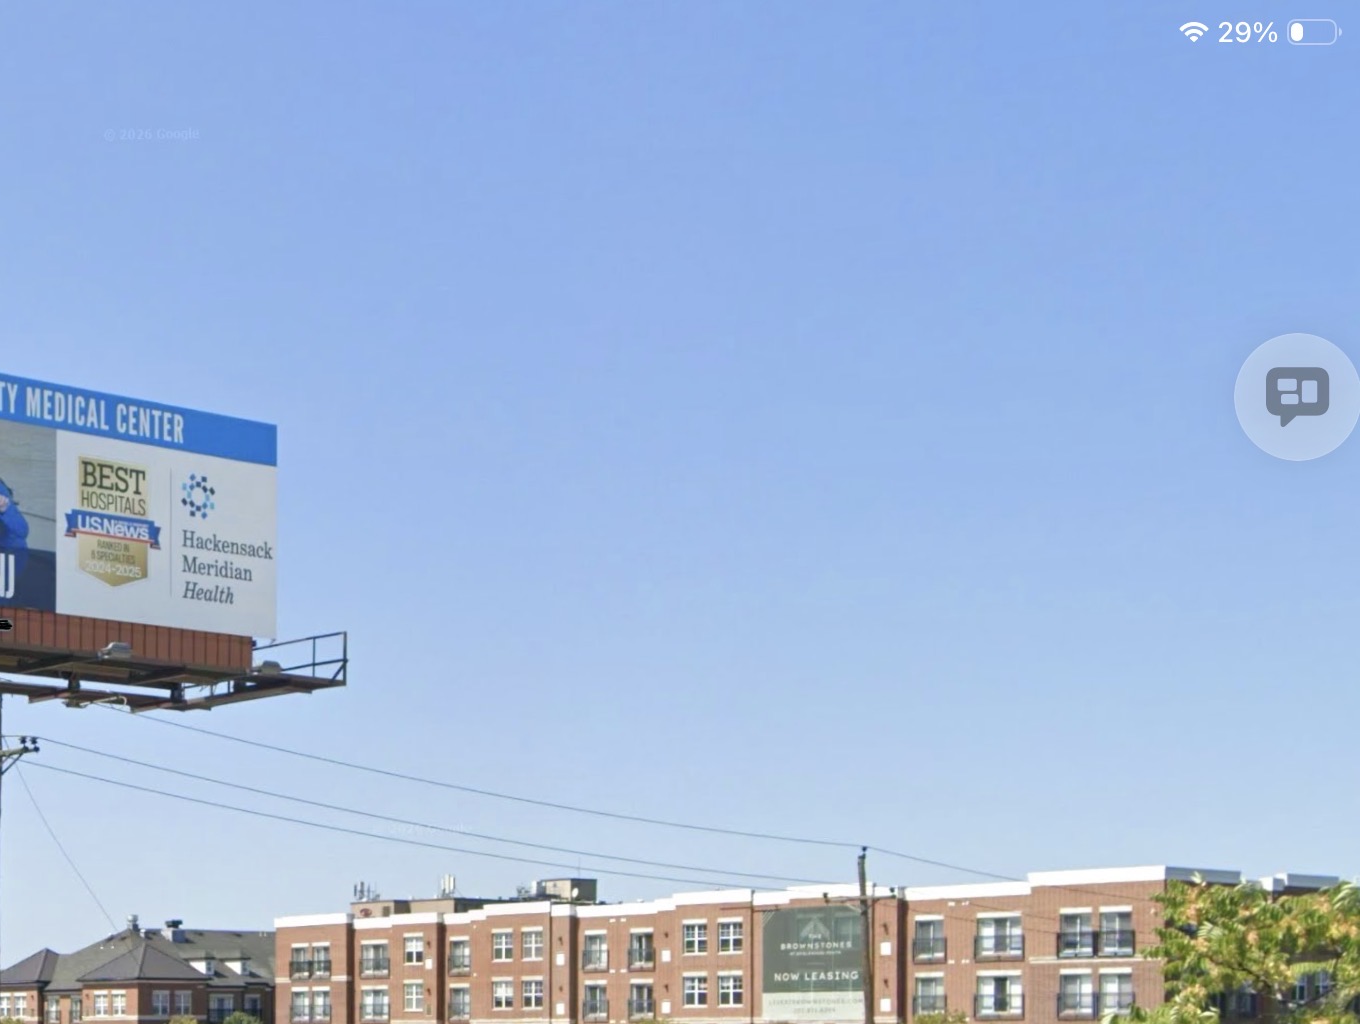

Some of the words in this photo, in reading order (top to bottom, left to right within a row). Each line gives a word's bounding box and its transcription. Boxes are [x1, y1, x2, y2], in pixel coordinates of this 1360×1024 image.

[26, 386, 110, 431] MEDICAL
[116, 403, 185, 444] CENTER
[81, 460, 146, 495] BEST
[80, 489, 147, 517] HOSPITALS
[181, 529, 274, 560] Hackensack
[84, 560, 142, 579] 2024-2025
[181, 554, 253, 582] Meridian
[181, 580, 235, 605] Health
[780, 941, 853, 951] BROWNSTONES
[774, 972, 800, 982] NOW
[804, 970, 859, 981] LEASING
